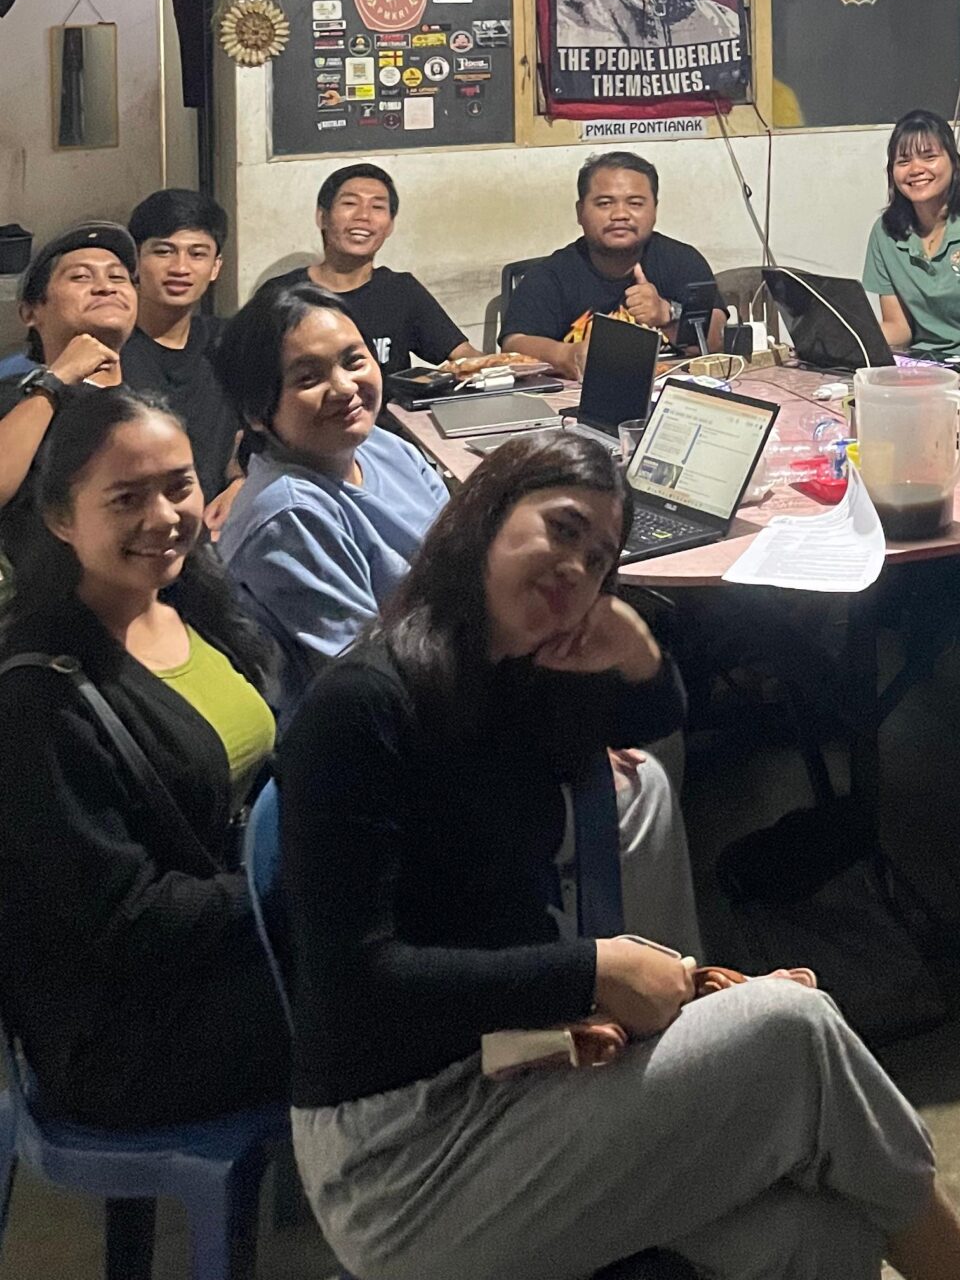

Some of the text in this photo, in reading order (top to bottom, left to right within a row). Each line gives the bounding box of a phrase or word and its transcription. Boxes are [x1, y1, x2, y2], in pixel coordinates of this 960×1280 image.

[557, 39, 742, 71] THE PEOPLE LIBERATE
[592, 71, 711, 97] THEMSELVES.
[585, 119, 703, 136] PMKRI PONTIANAK
